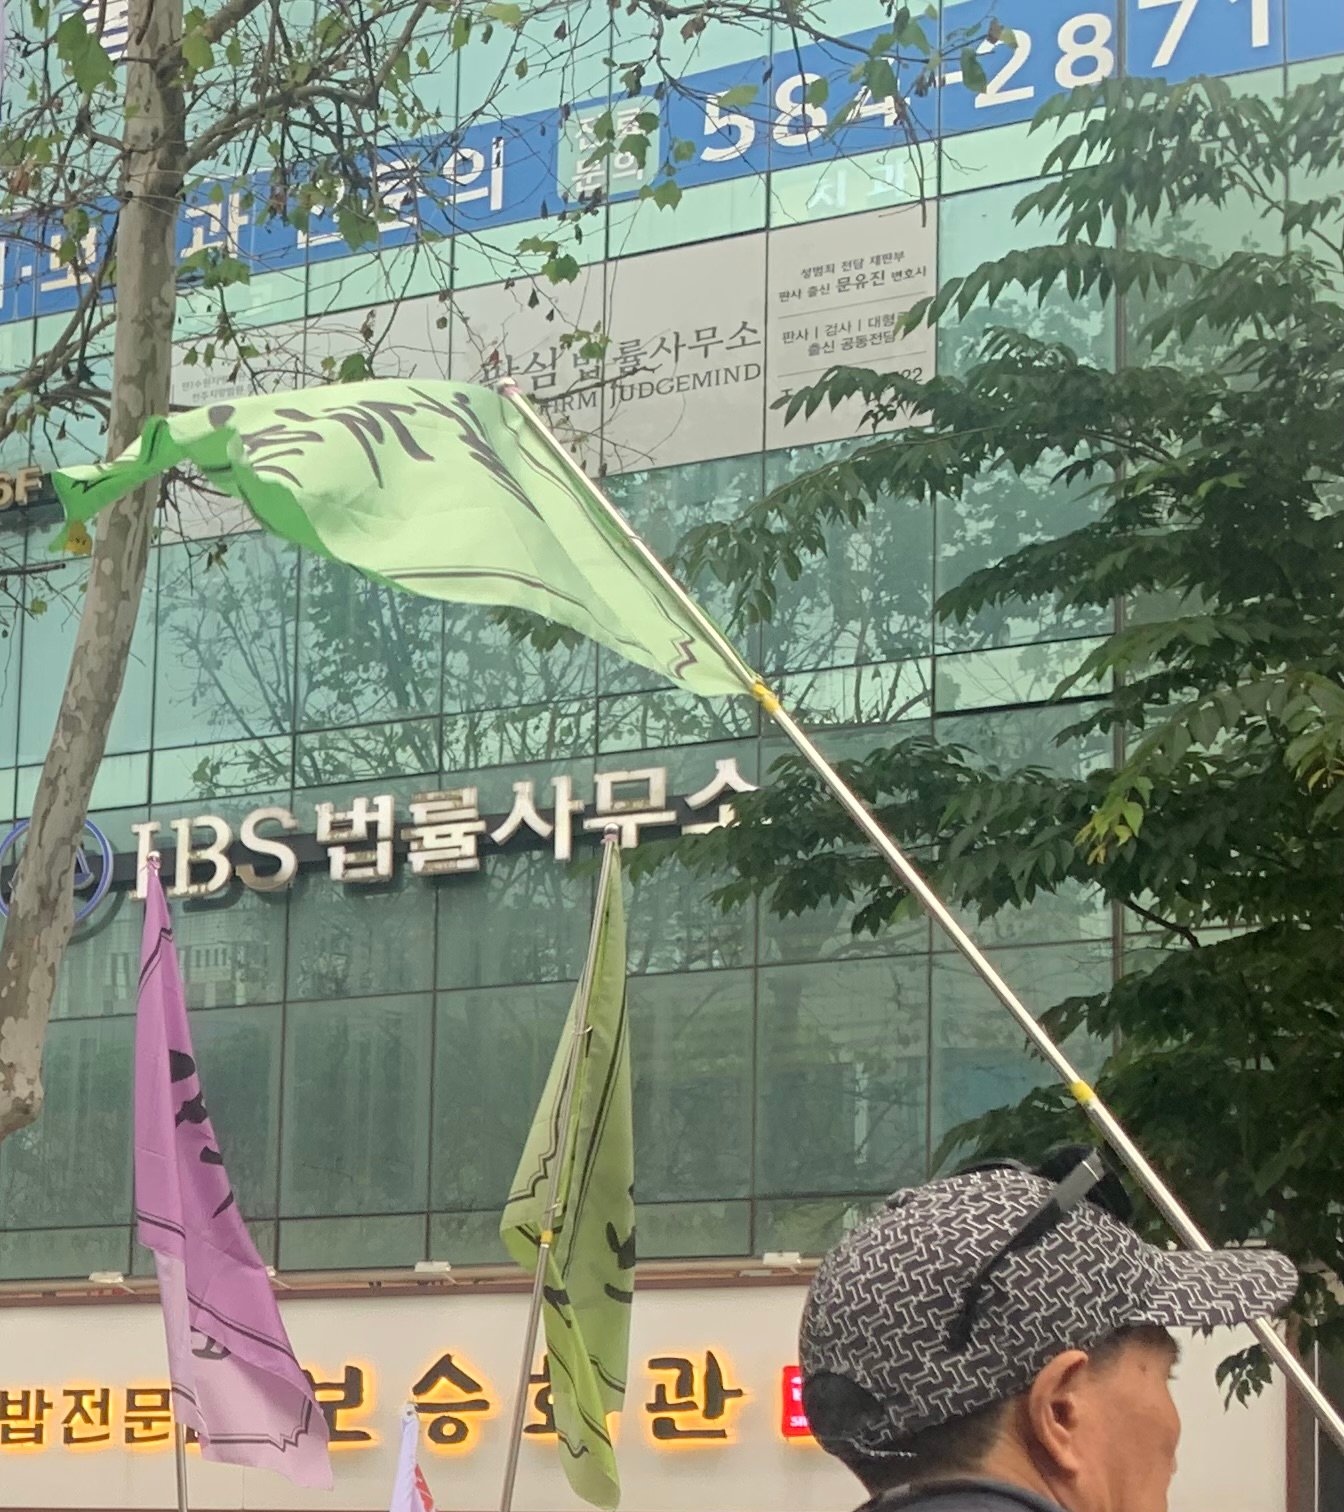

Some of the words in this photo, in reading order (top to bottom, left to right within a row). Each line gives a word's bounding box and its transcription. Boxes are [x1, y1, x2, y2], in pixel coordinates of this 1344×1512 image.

[779, 287, 803, 303] 판사
[836, 270, 886, 294] 문유진
[781, 329, 810, 345] 판사
[868, 312, 897, 329] 대형
[609, 362, 762, 408] JUDGEMIND
[314, 758, 759, 882] 법률사무소
[130, 806, 299, 902] IBS
